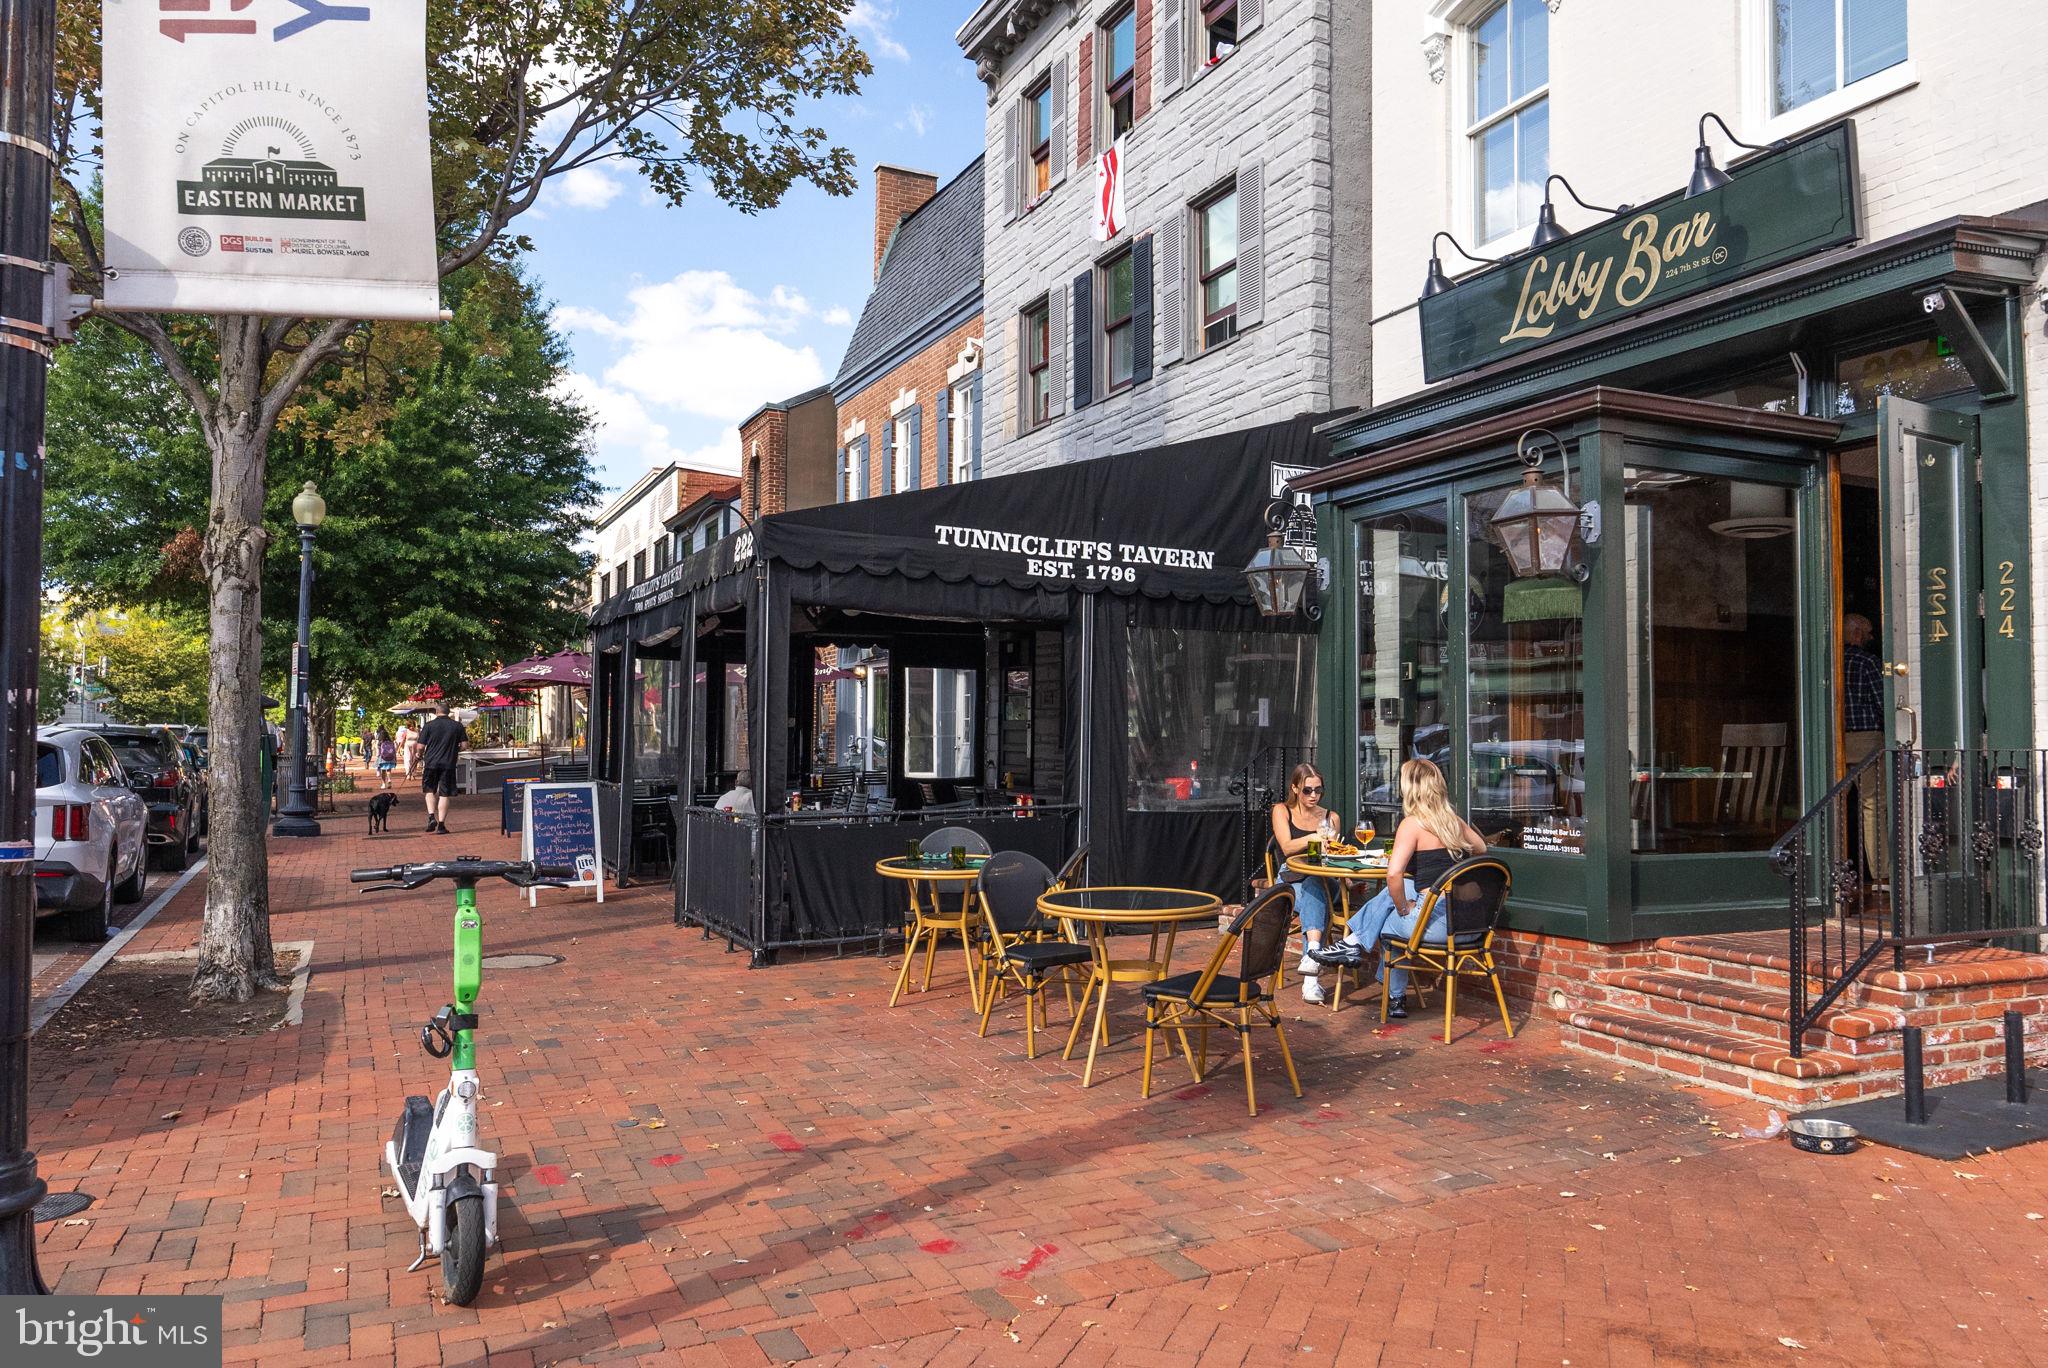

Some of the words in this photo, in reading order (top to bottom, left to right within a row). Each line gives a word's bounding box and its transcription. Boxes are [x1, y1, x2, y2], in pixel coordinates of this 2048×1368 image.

[175, 132, 190, 154] ON
[186, 83, 247, 127] CAPITOL
[253, 80, 292, 93] HILL
[298, 88, 343, 125] SINCE
[341, 127, 362, 161] 1873
[184, 189, 273, 209] EASTERN
[278, 192, 358, 213] MARKET
[222, 236, 242, 245] DGS
[1715, 250, 1725, 260] DC
[1500, 251, 1613, 343] Lobby
[1615, 207, 1717, 307] Bar
[1665, 267, 1678, 279] 224
[1679, 263, 1691, 273] 7th
[1692, 260, 1700, 269] St
[1701, 256, 1711, 265] SE
[733, 530, 754, 563] 222
[934, 525, 1112, 561] TUNNICLIFFS
[1119, 544, 1215, 571] TAVERN
[1026, 559, 1076, 580] EST.
[1085, 564, 1136, 583] 1796
[1536, 836, 1552, 844] Lobby
[1569, 829, 1581, 837] LLC
[577, 858, 594, 870] Lite
